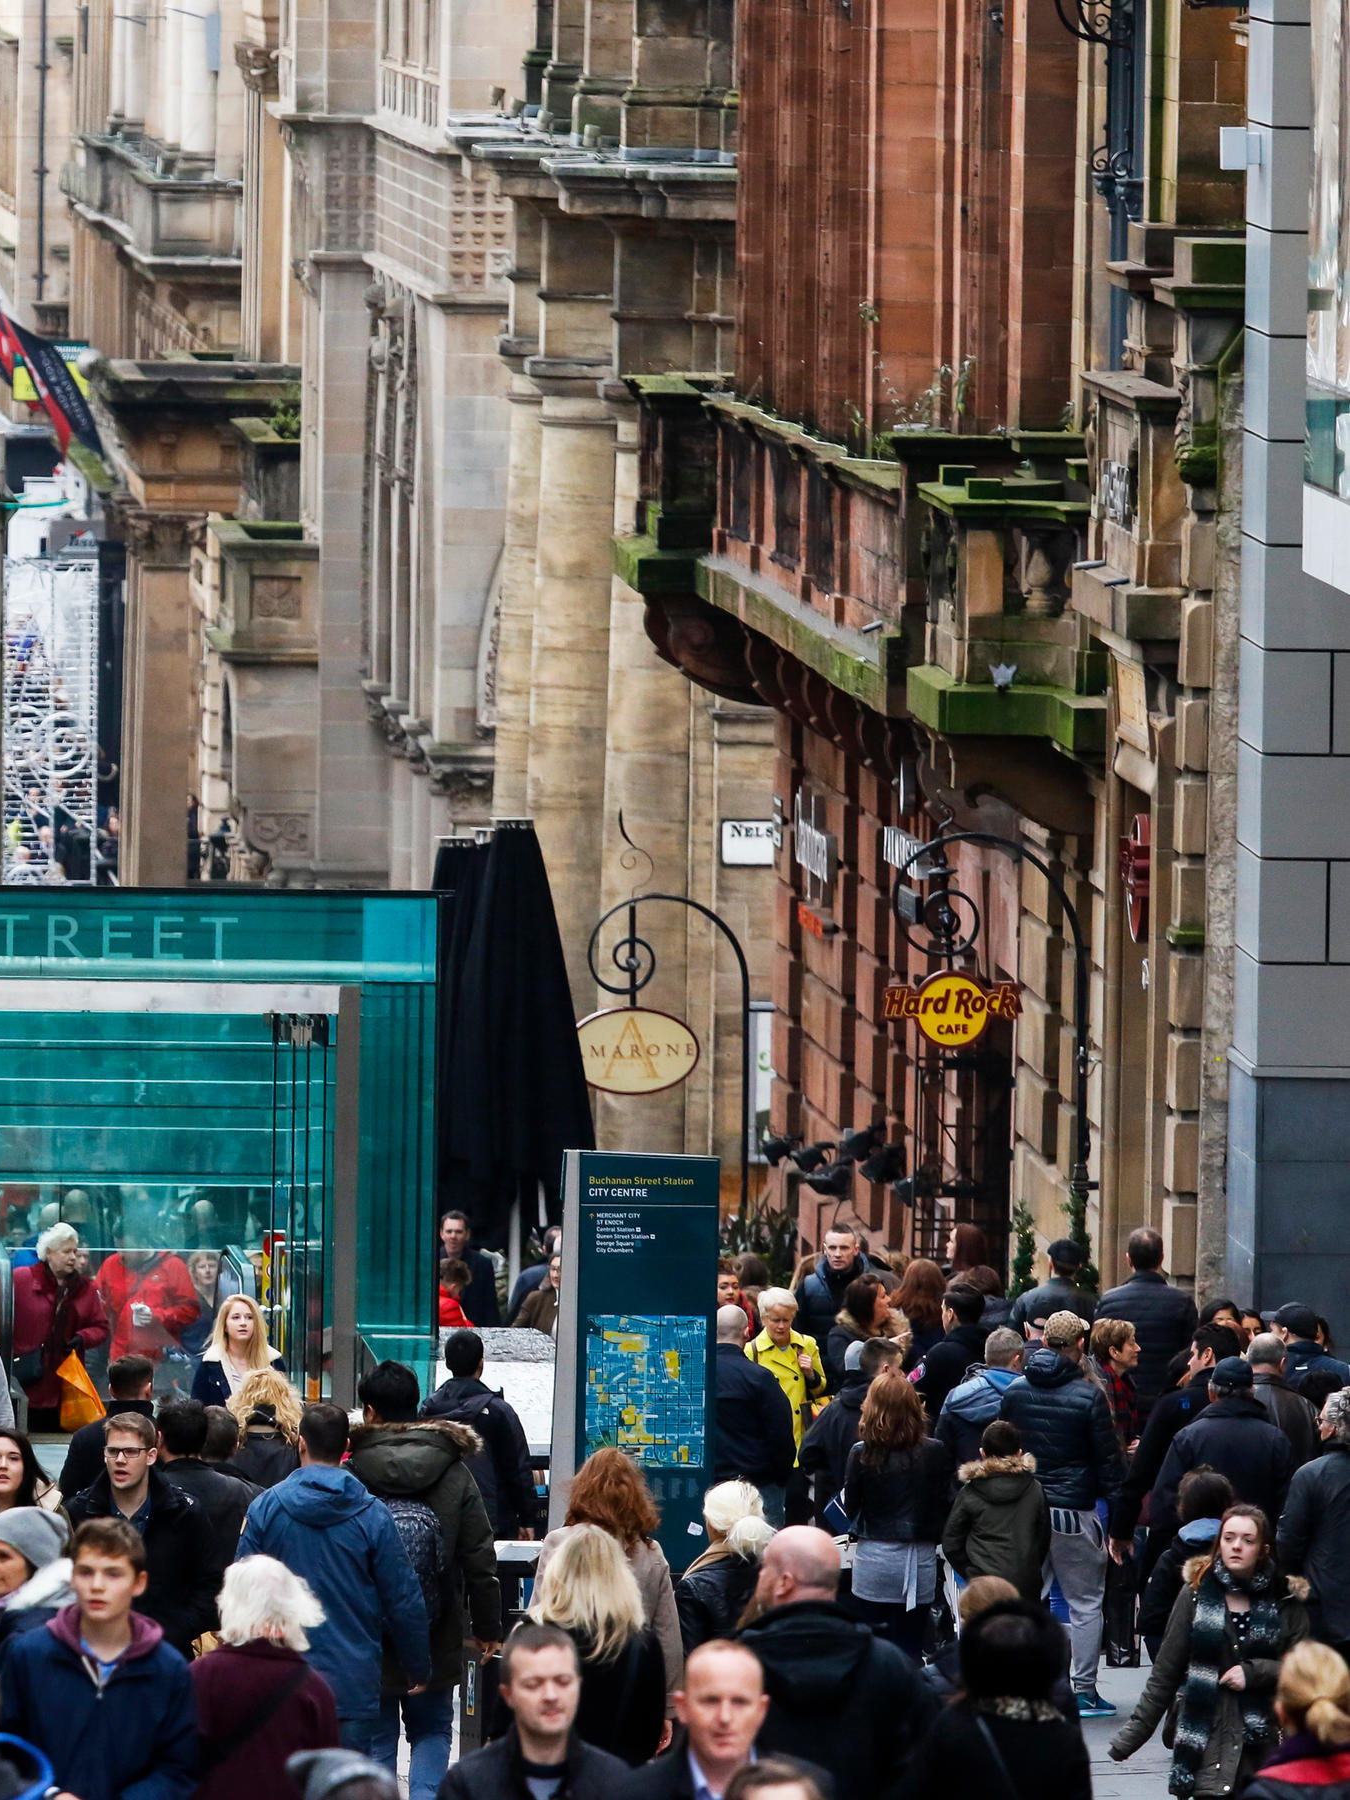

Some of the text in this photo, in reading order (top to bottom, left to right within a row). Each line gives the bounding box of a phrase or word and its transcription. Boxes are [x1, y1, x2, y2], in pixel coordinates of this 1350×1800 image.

[885, 985, 1020, 1019] Hard Rock
[937, 1023, 968, 1035] CAFE
[581, 1043, 694, 1058] MARONE
[589, 1176, 694, 1185] Buchanan Street Station
[589, 1188, 608, 1196] CITY
